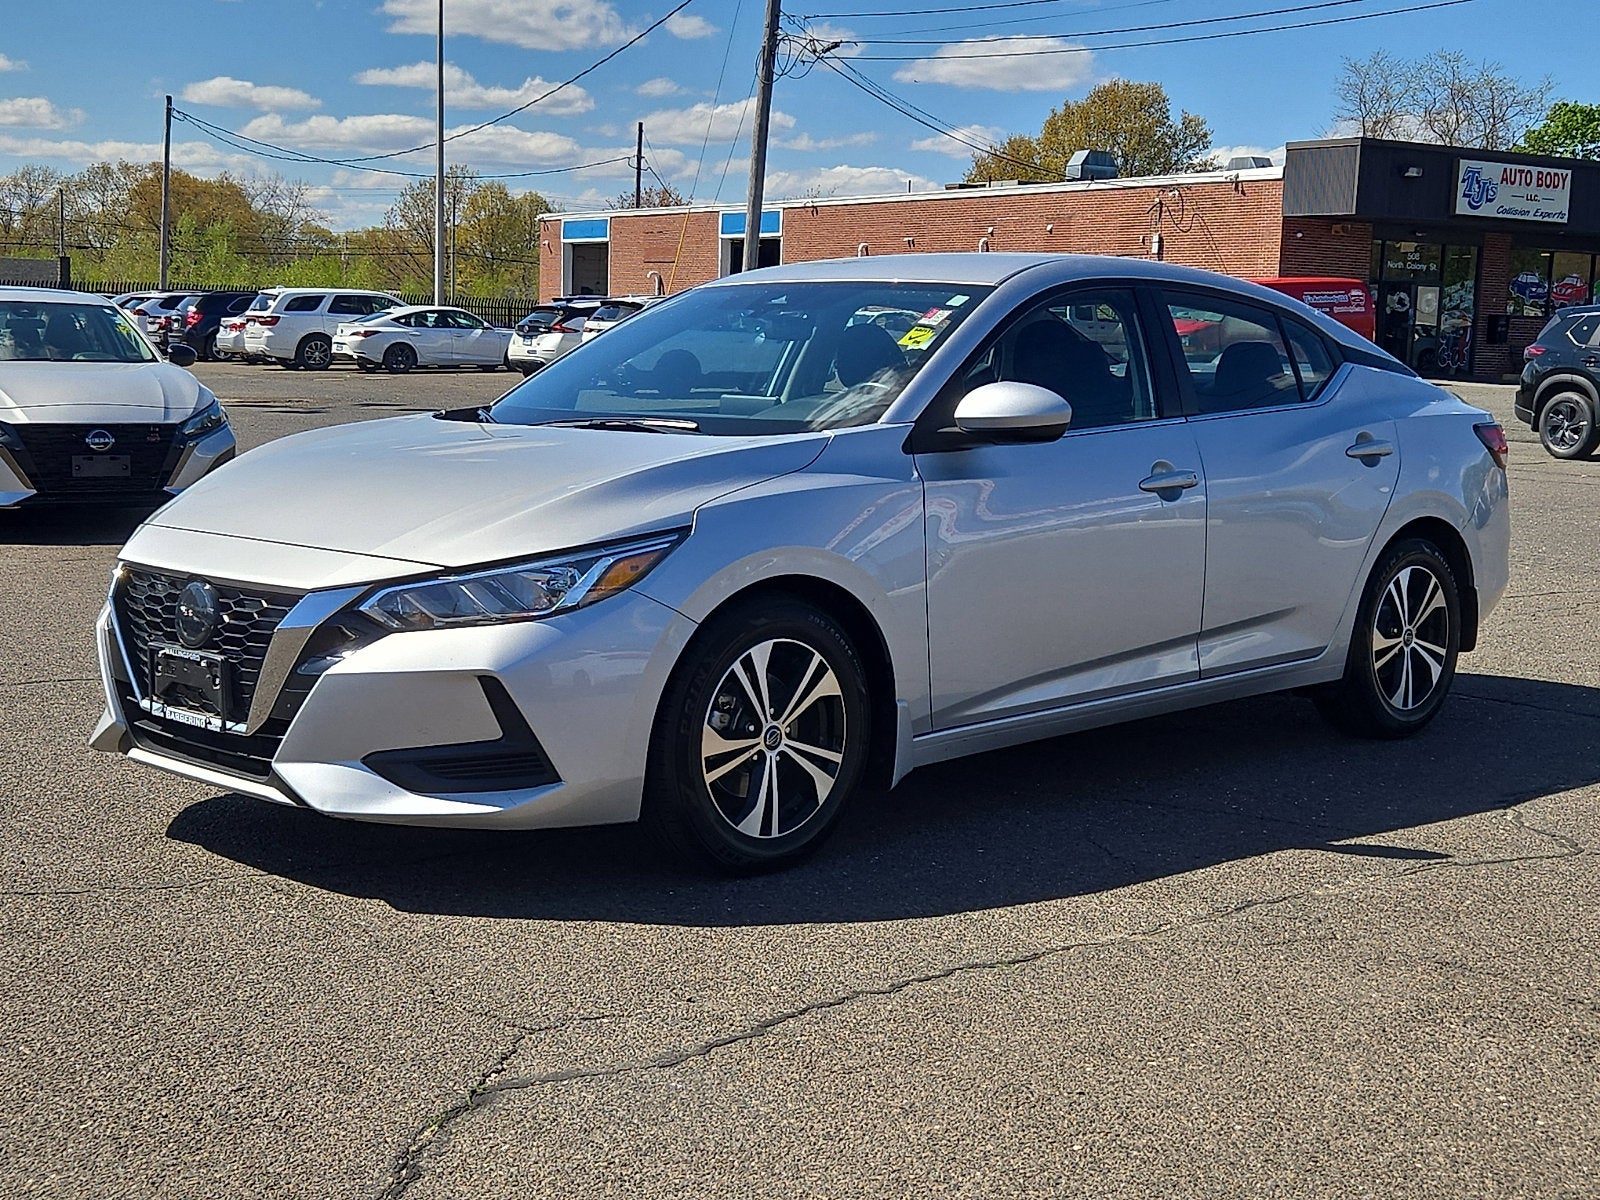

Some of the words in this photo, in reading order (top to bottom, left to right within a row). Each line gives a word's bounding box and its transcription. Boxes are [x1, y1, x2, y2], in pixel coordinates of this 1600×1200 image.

[1461, 166, 1498, 210] TJ's
[1500, 168, 1532, 187] AUTO
[1536, 171, 1568, 190] BODY
[1496, 205, 1530, 217] Collision
[1533, 208, 1566, 220] Experts
[1387, 260, 1404, 269] North
[1406, 261, 1427, 271] Colony
